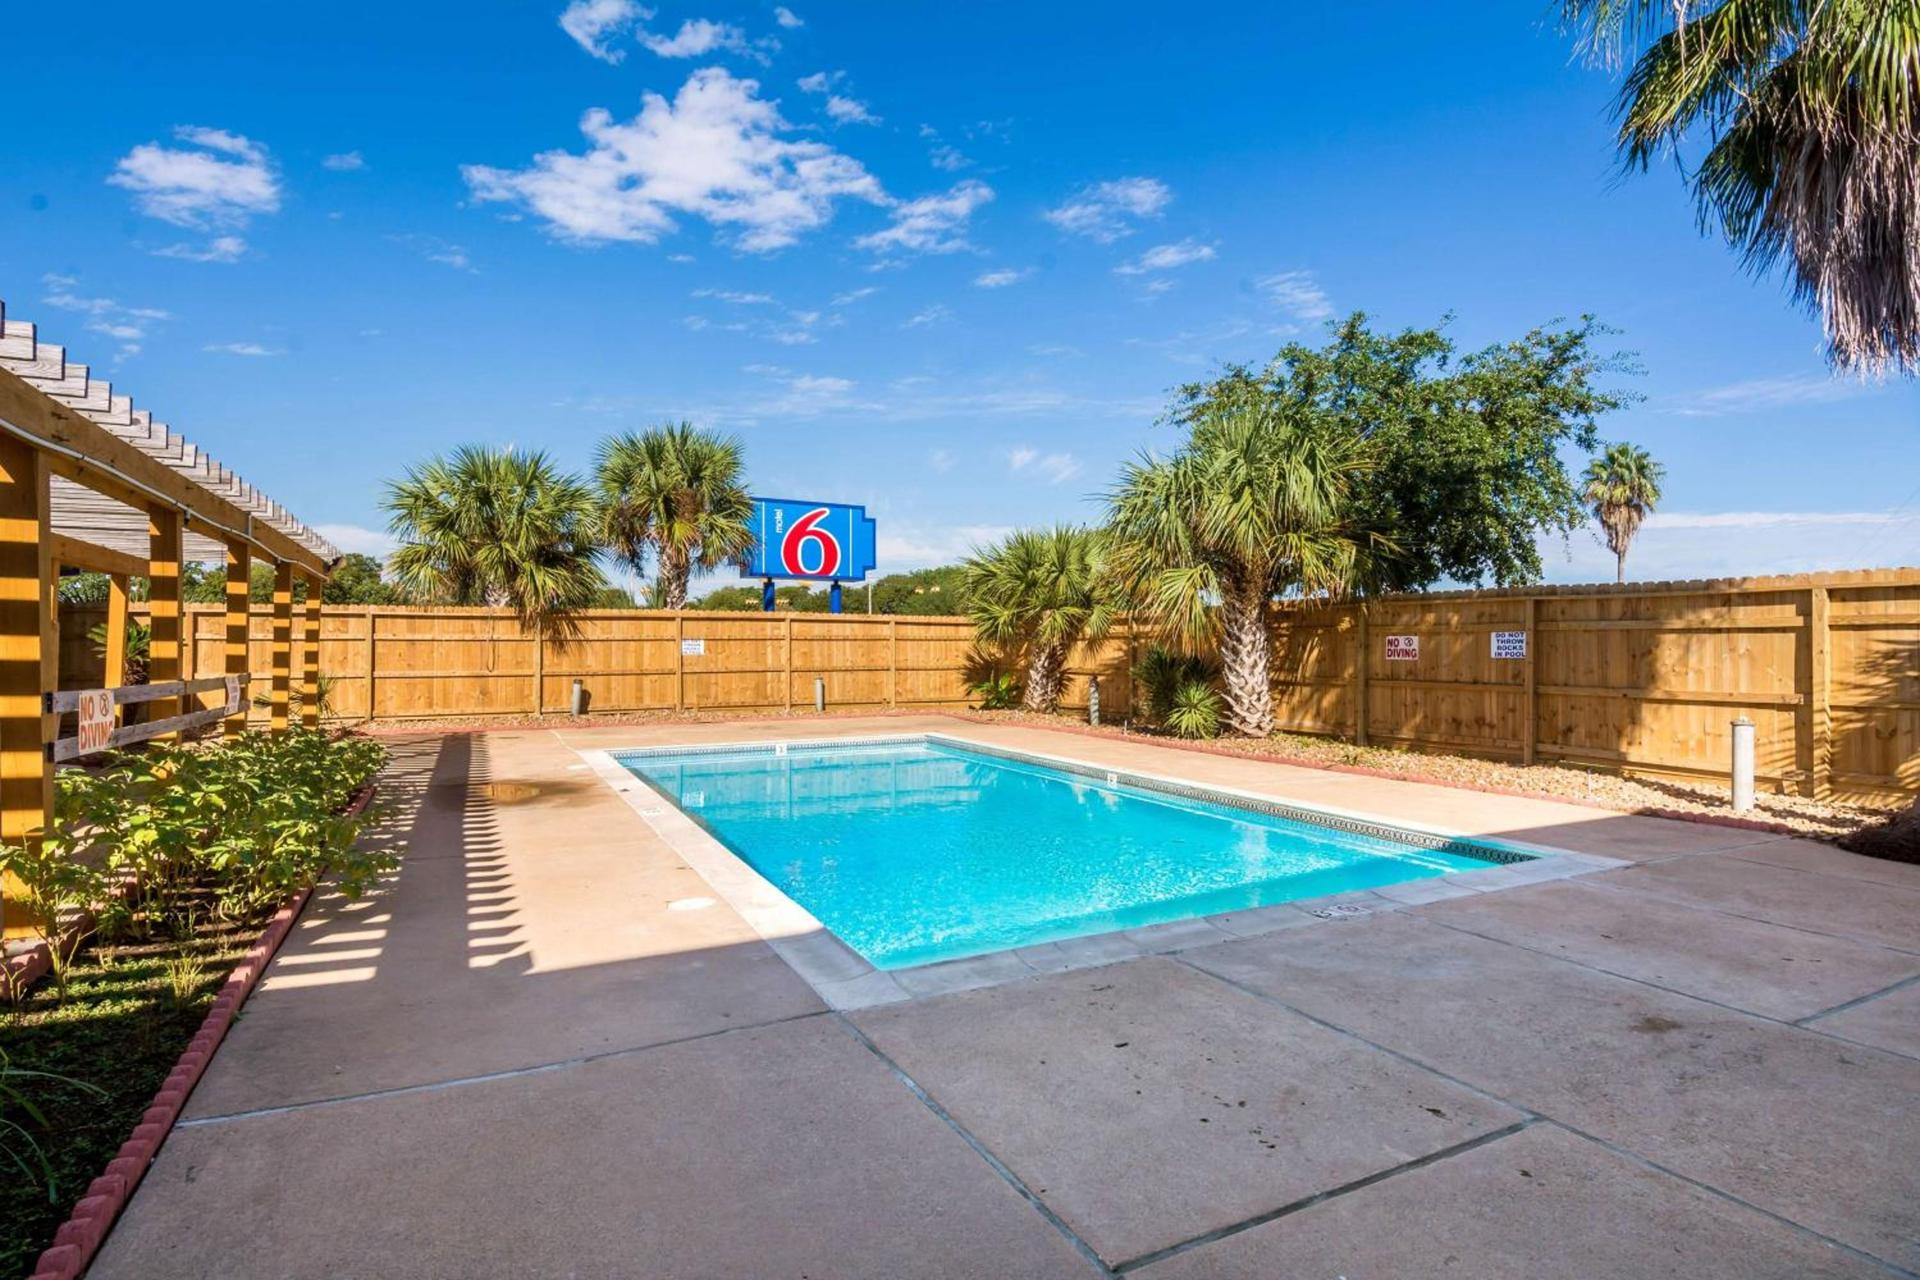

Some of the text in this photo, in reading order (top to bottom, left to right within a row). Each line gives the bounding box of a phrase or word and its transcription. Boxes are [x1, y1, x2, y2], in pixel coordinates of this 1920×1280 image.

[781, 507, 841, 576] 6
[1387, 638, 1400, 647] NO
[1387, 648, 1417, 658] DIVING
[80, 695, 95, 722] NO
